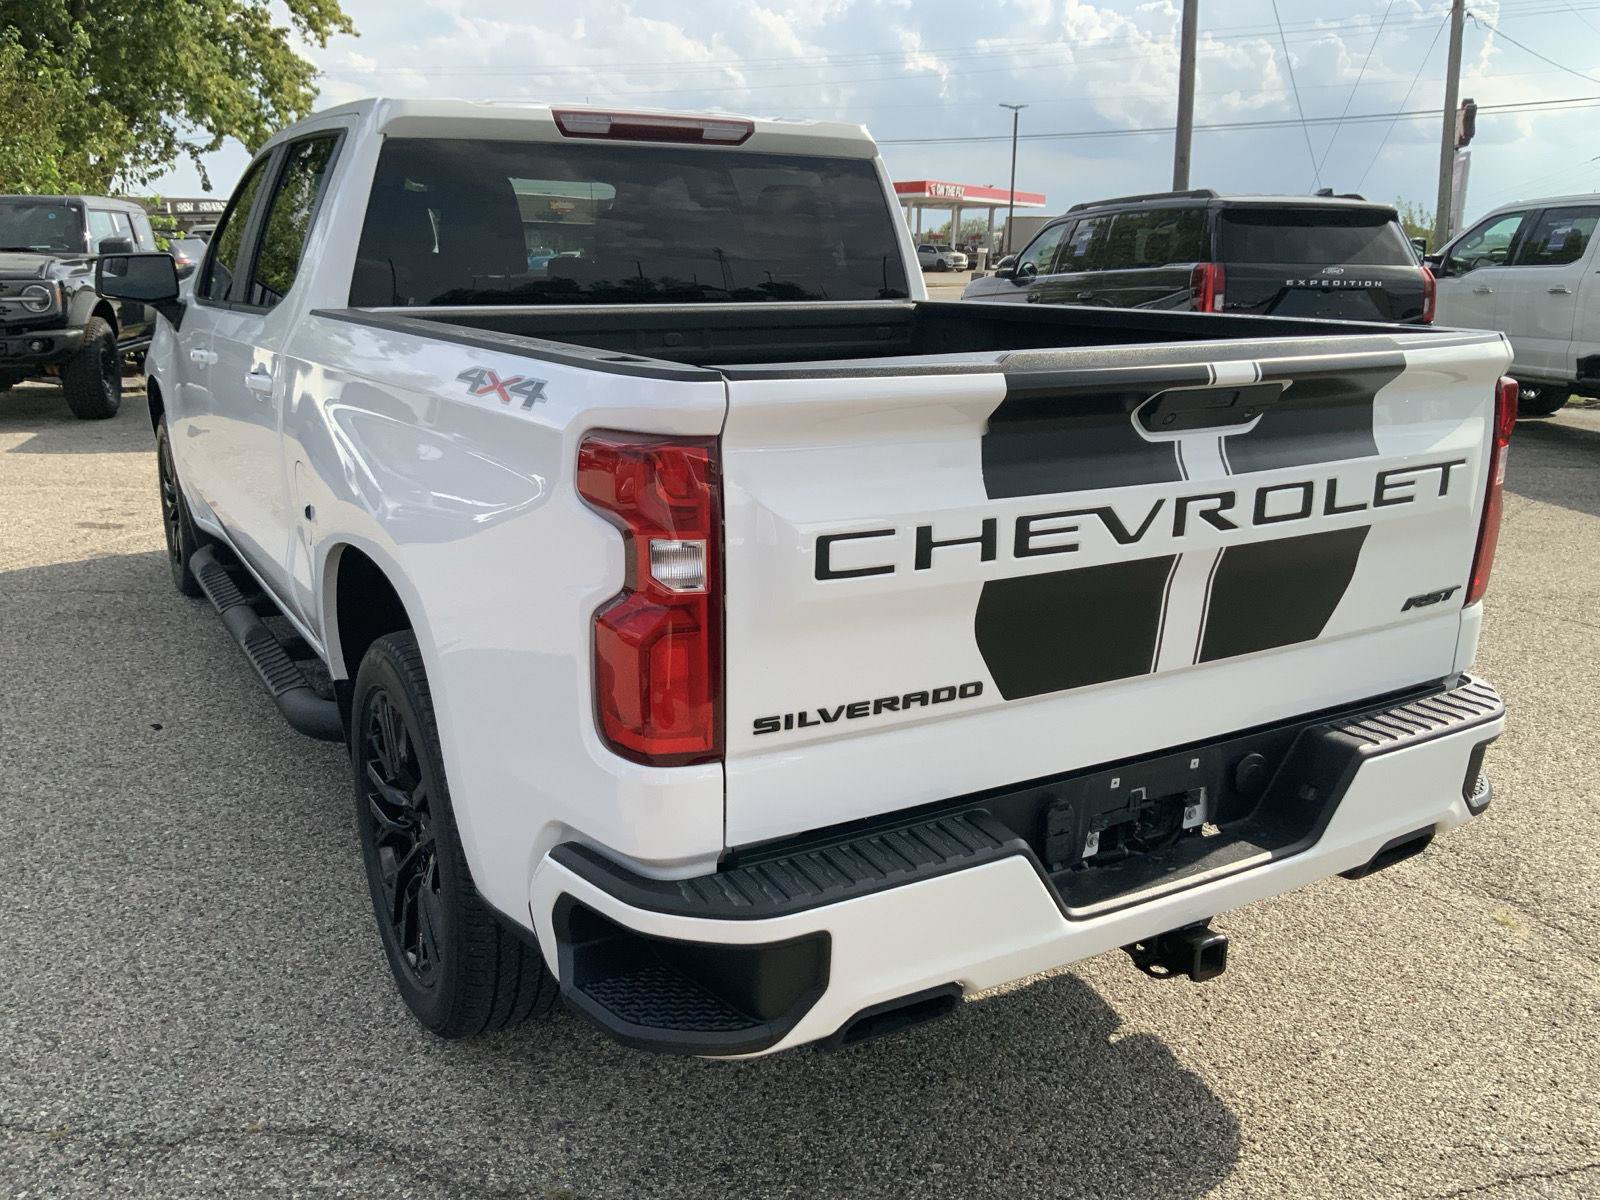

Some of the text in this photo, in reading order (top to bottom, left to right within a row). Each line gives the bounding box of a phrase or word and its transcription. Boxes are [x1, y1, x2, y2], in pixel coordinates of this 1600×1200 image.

[1285, 279, 1383, 287] EXPEDITION
[814, 458, 1467, 582] CHEVROLET
[1400, 585, 1462, 612] RST
[753, 681, 983, 735] SILVERADO
